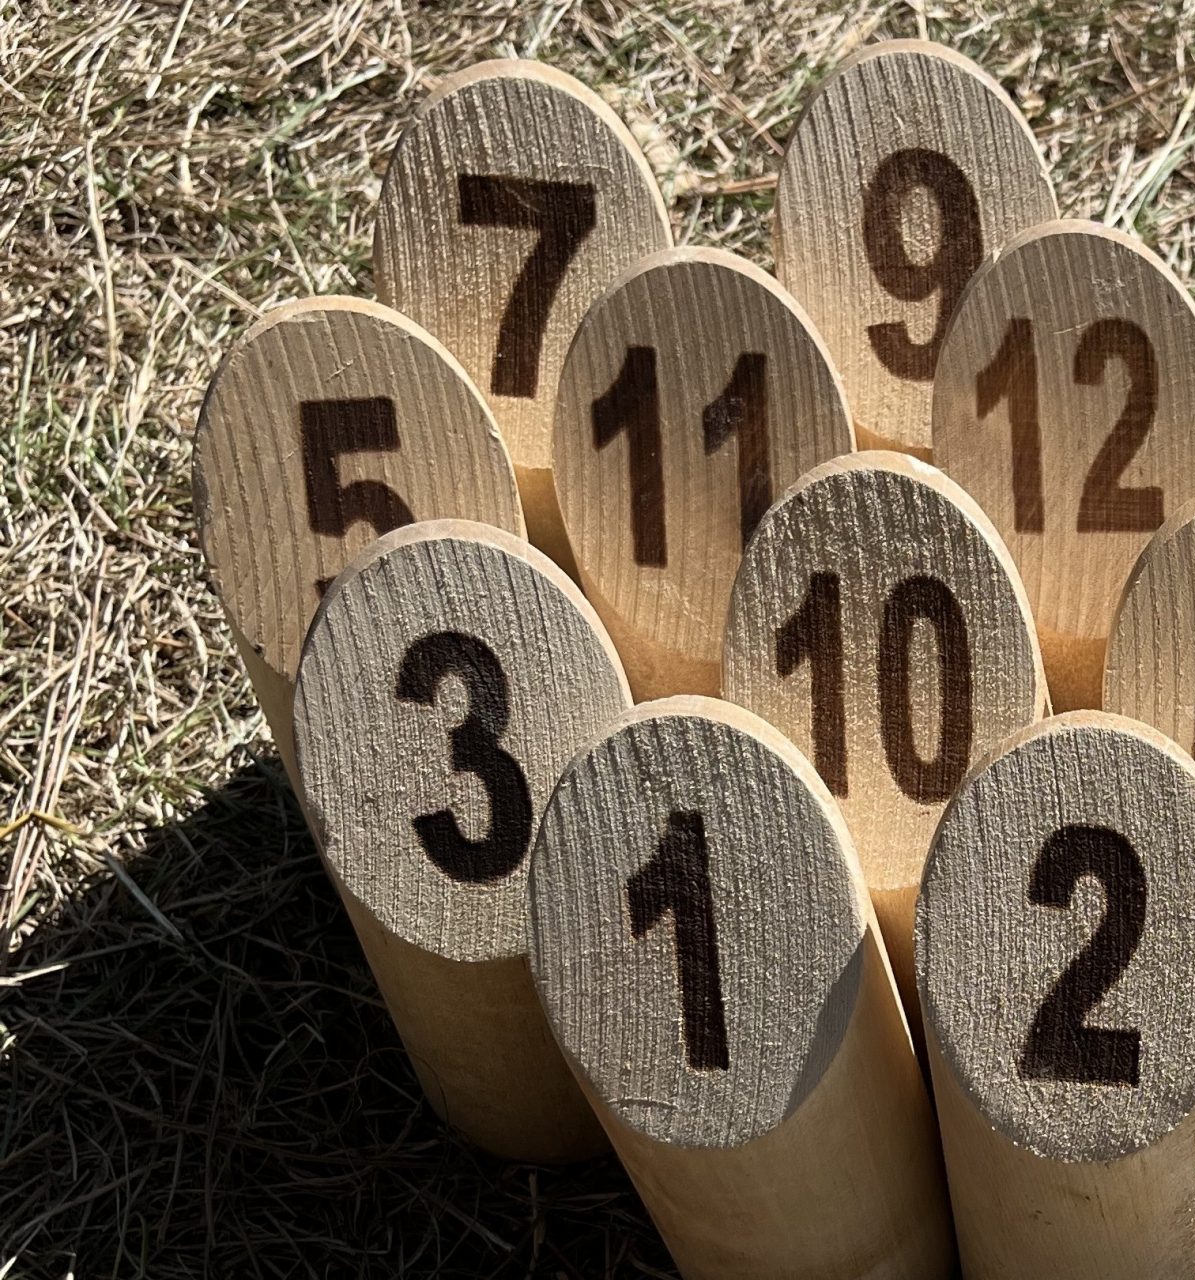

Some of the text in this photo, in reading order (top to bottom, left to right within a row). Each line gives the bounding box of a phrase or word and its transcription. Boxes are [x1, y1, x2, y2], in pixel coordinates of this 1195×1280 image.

[457, 173, 597, 397] 7
[863, 147, 984, 382] 9
[300, 397, 417, 600] 5
[591, 346, 773, 568] 11
[975, 318, 1165, 533] 12
[395, 630, 532, 886] 3
[776, 571, 974, 804] 10
[626, 810, 730, 1073] 1
[1018, 823, 1147, 1088] 2
